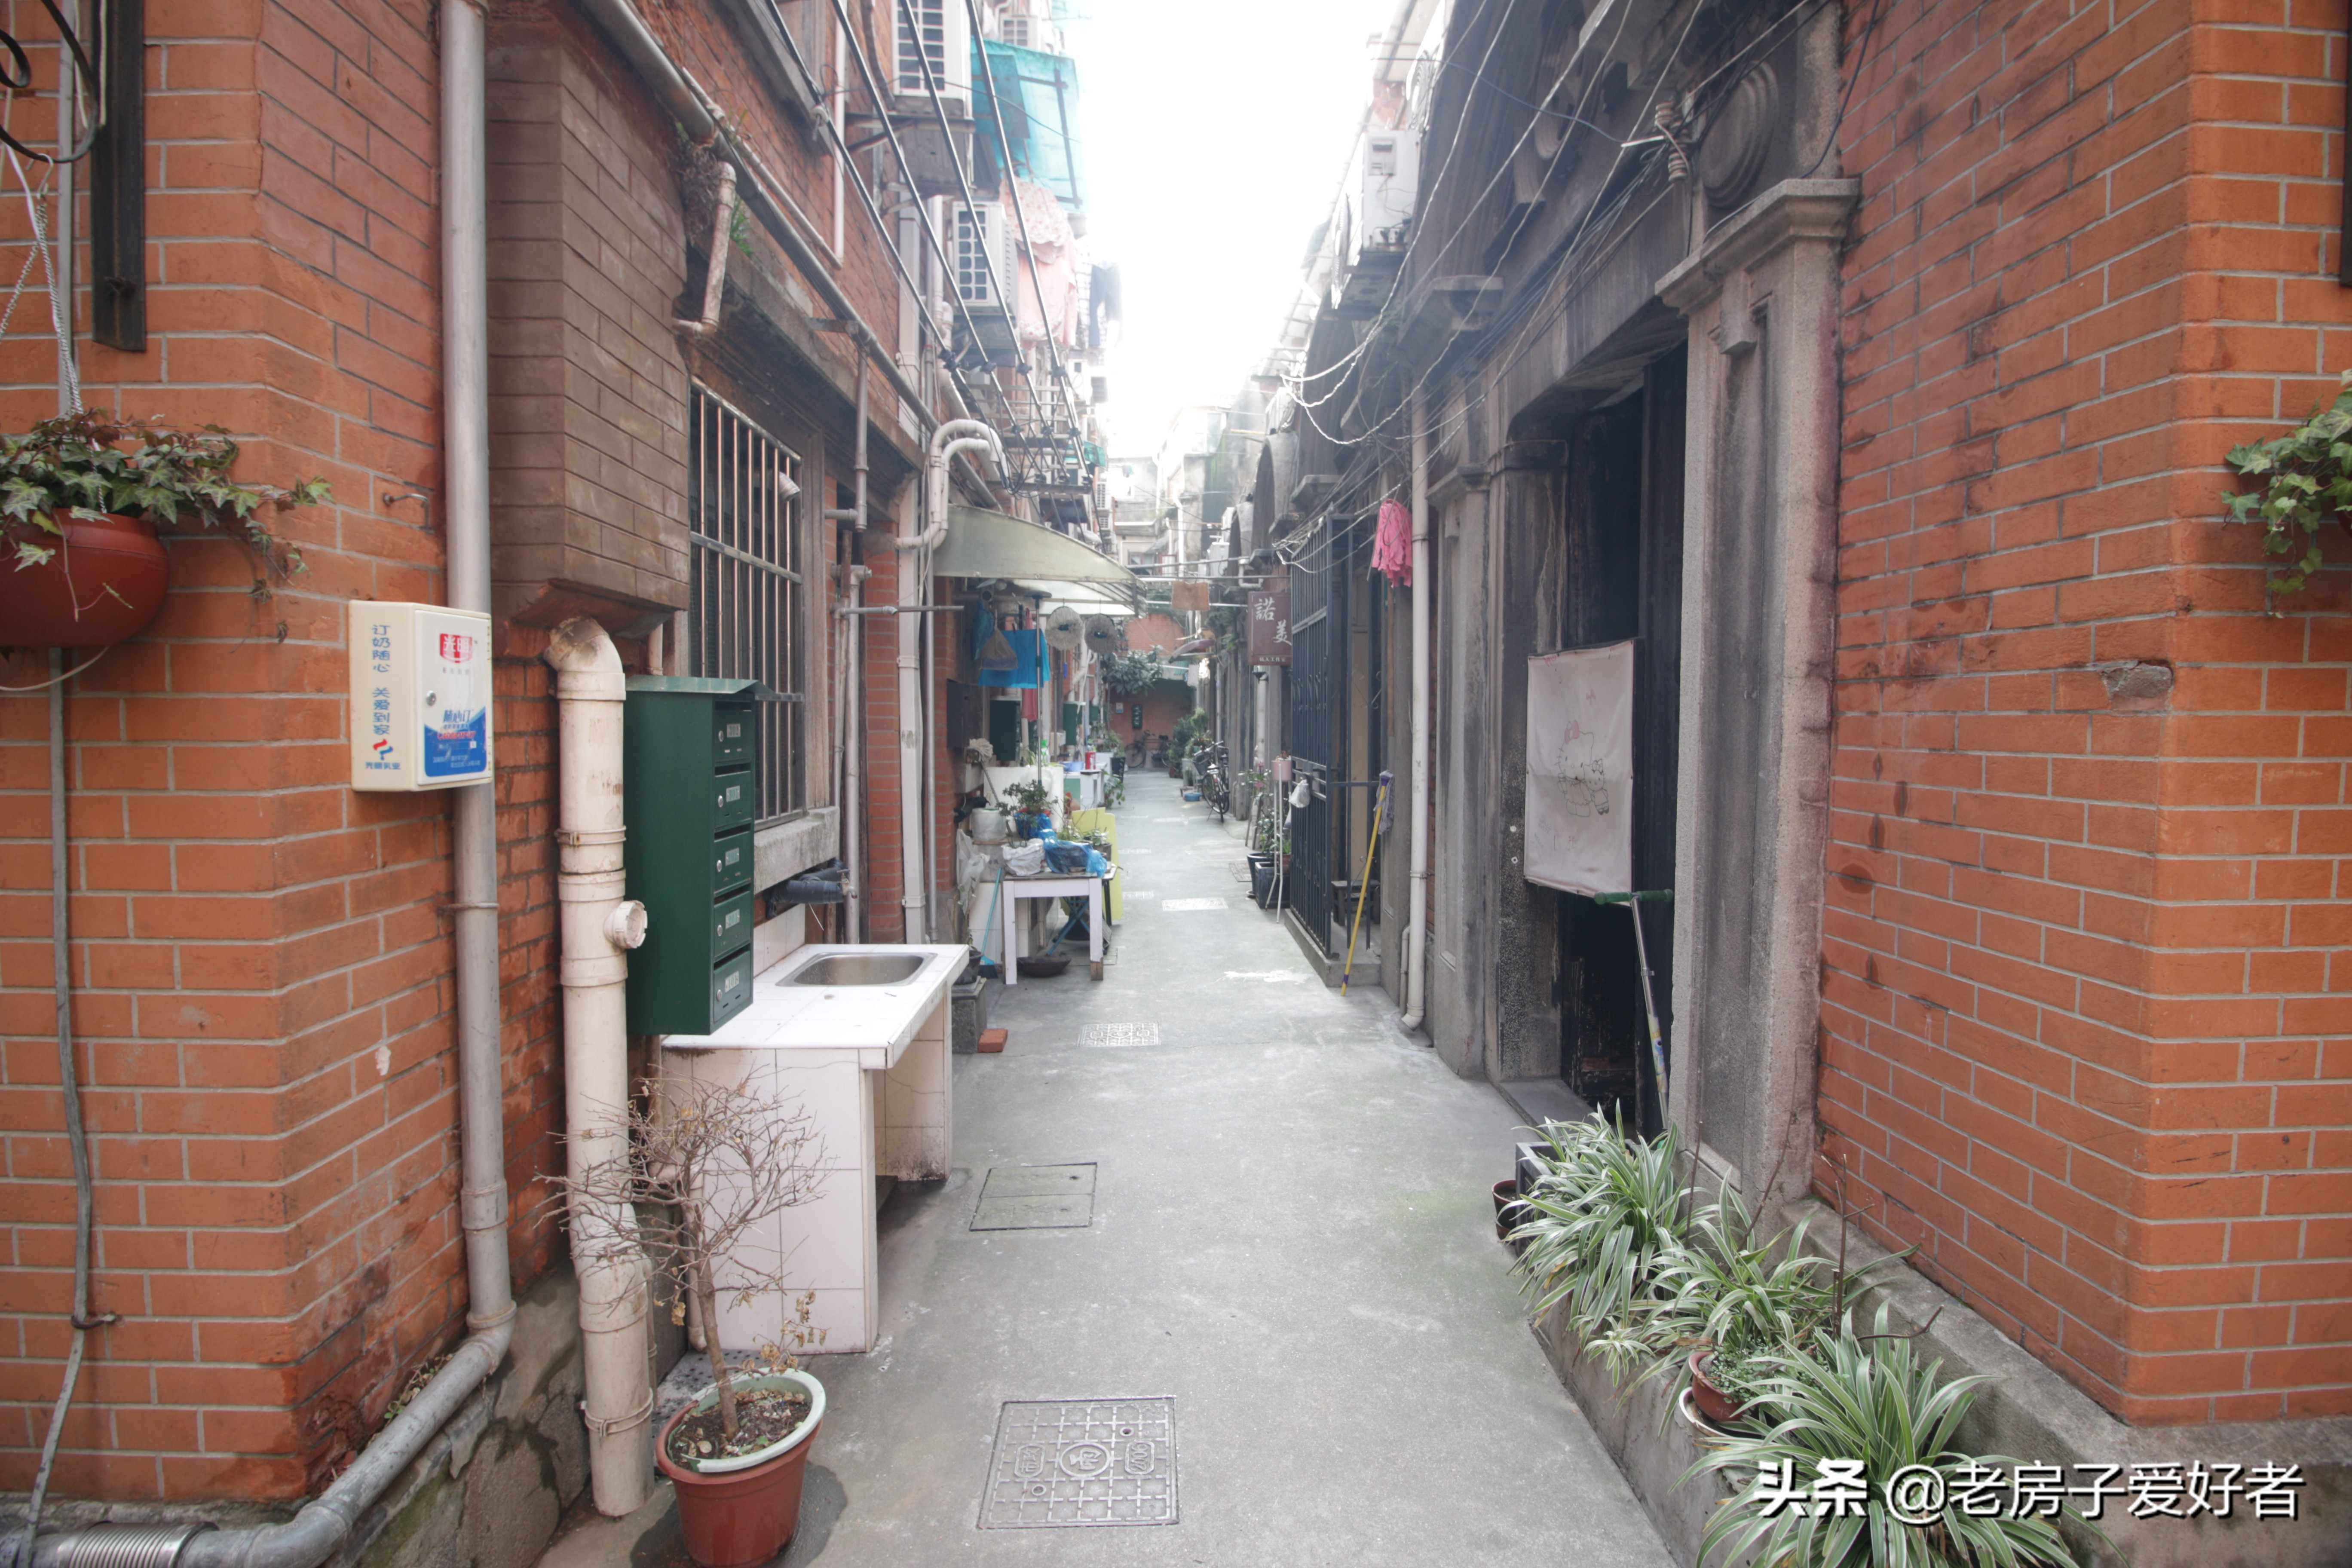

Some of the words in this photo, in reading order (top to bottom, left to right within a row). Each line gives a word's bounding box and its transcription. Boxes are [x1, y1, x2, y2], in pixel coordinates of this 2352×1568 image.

[371, 625, 391, 673] 订奶随心
[443, 635, 469, 653] 光明
[372, 687, 390, 735] 关爱到家
[443, 709, 472, 723] 随心订
[1020, 1446, 1040, 1473] 市政
[1069, 1448, 1101, 1470] 雨
[1130, 1442, 1148, 1472] 2006
